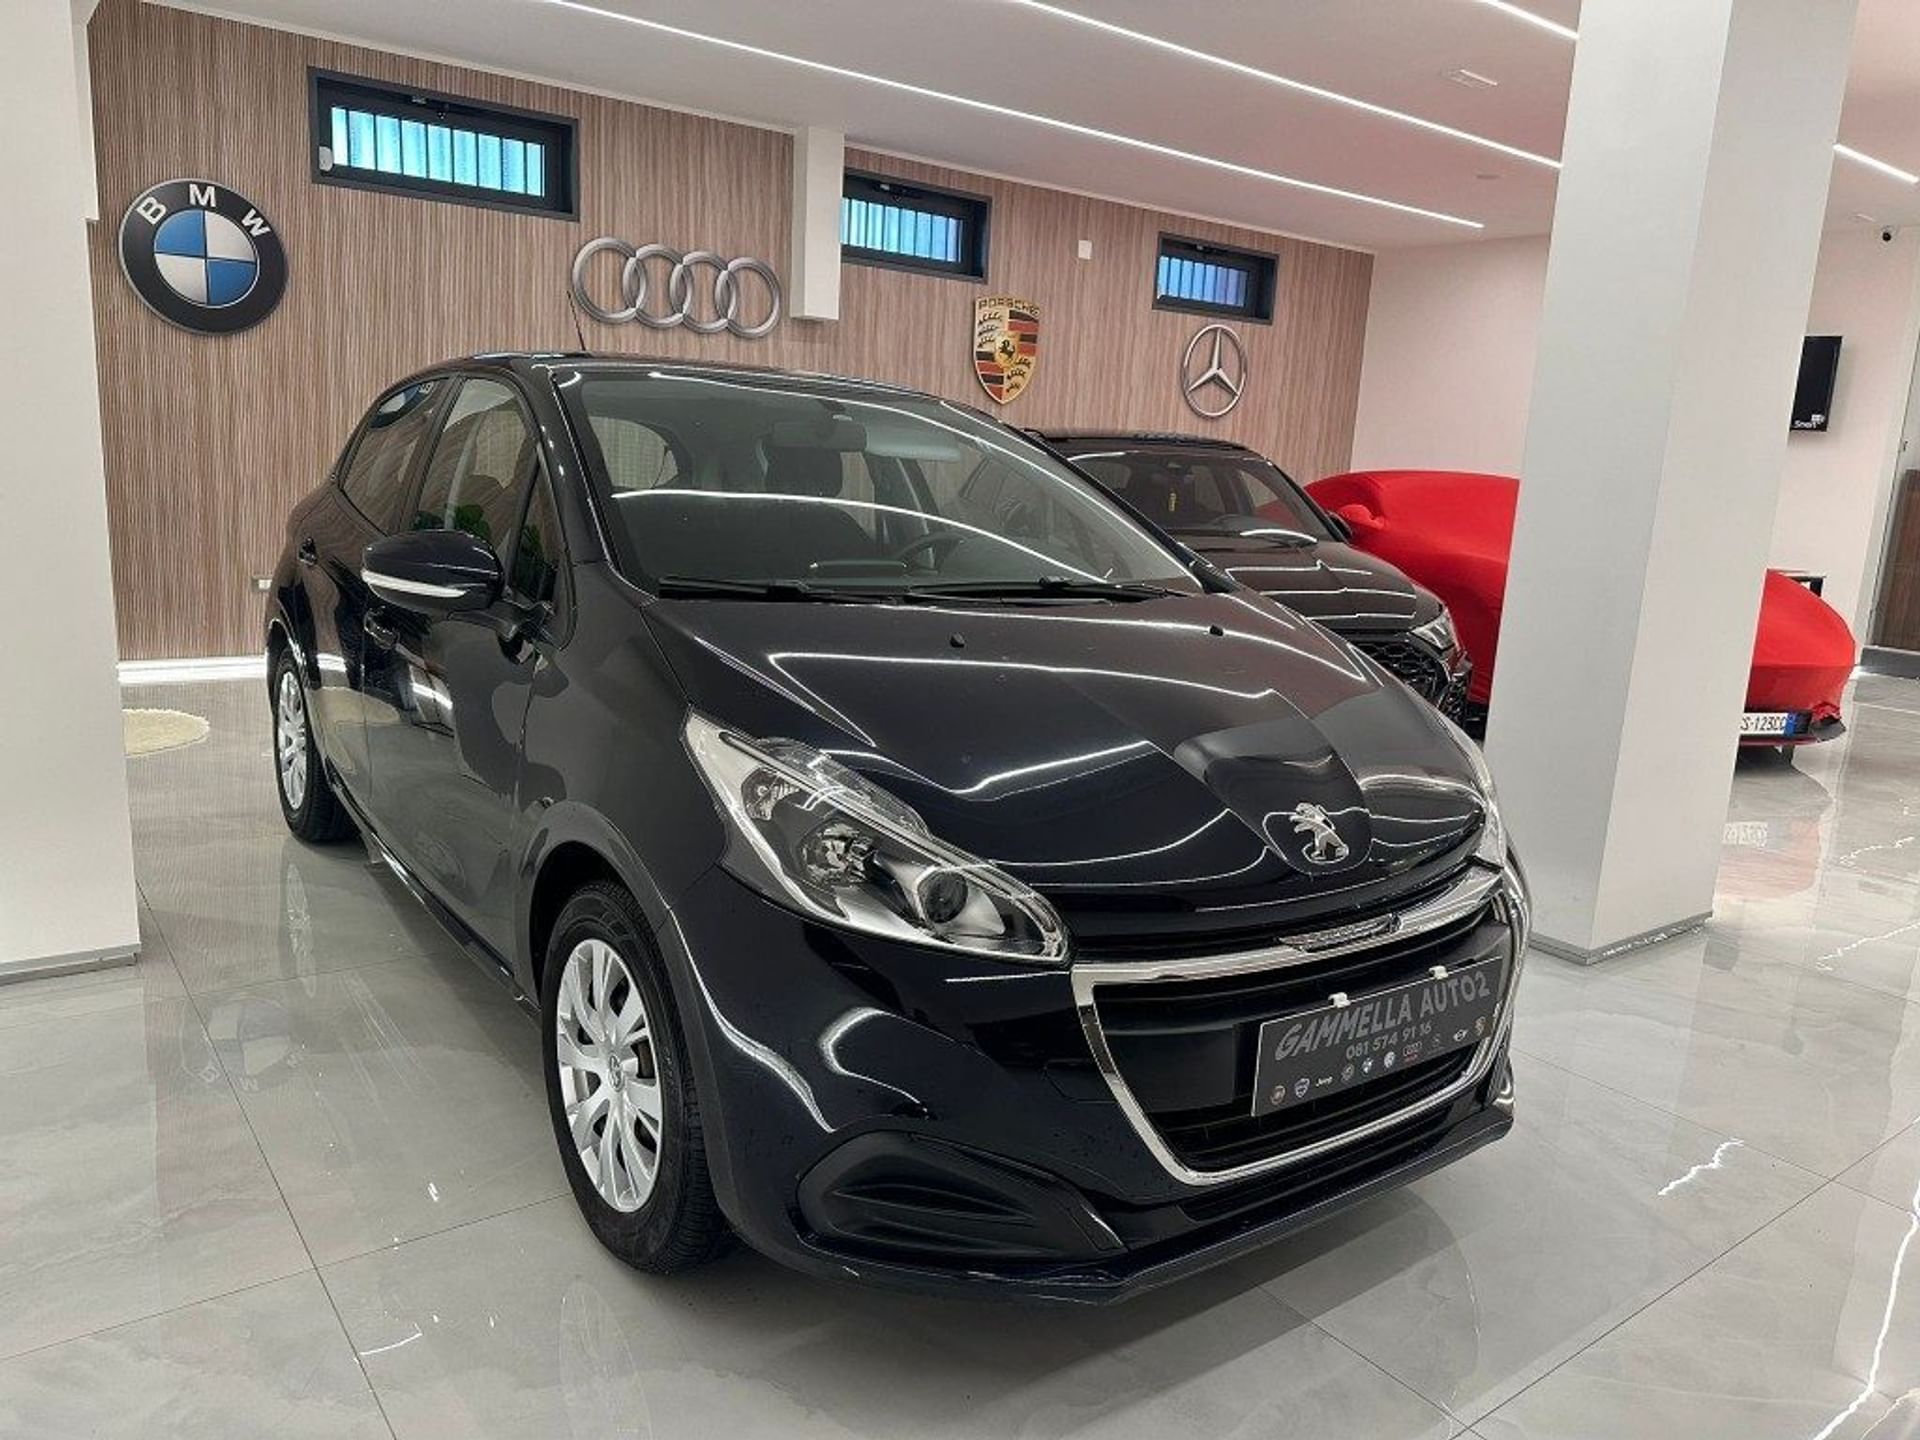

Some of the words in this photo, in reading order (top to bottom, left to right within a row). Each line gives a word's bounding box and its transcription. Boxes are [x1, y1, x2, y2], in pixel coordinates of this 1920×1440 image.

[136, 183, 271, 238] BMW
[979, 297, 1040, 317] PORSCHE
[1275, 994, 1411, 1060] GAMMELLA
[1419, 971, 1490, 1018] AUTO2
[1346, 1041, 1369, 1060] 081
[1372, 1032, 1398, 1051] 574
